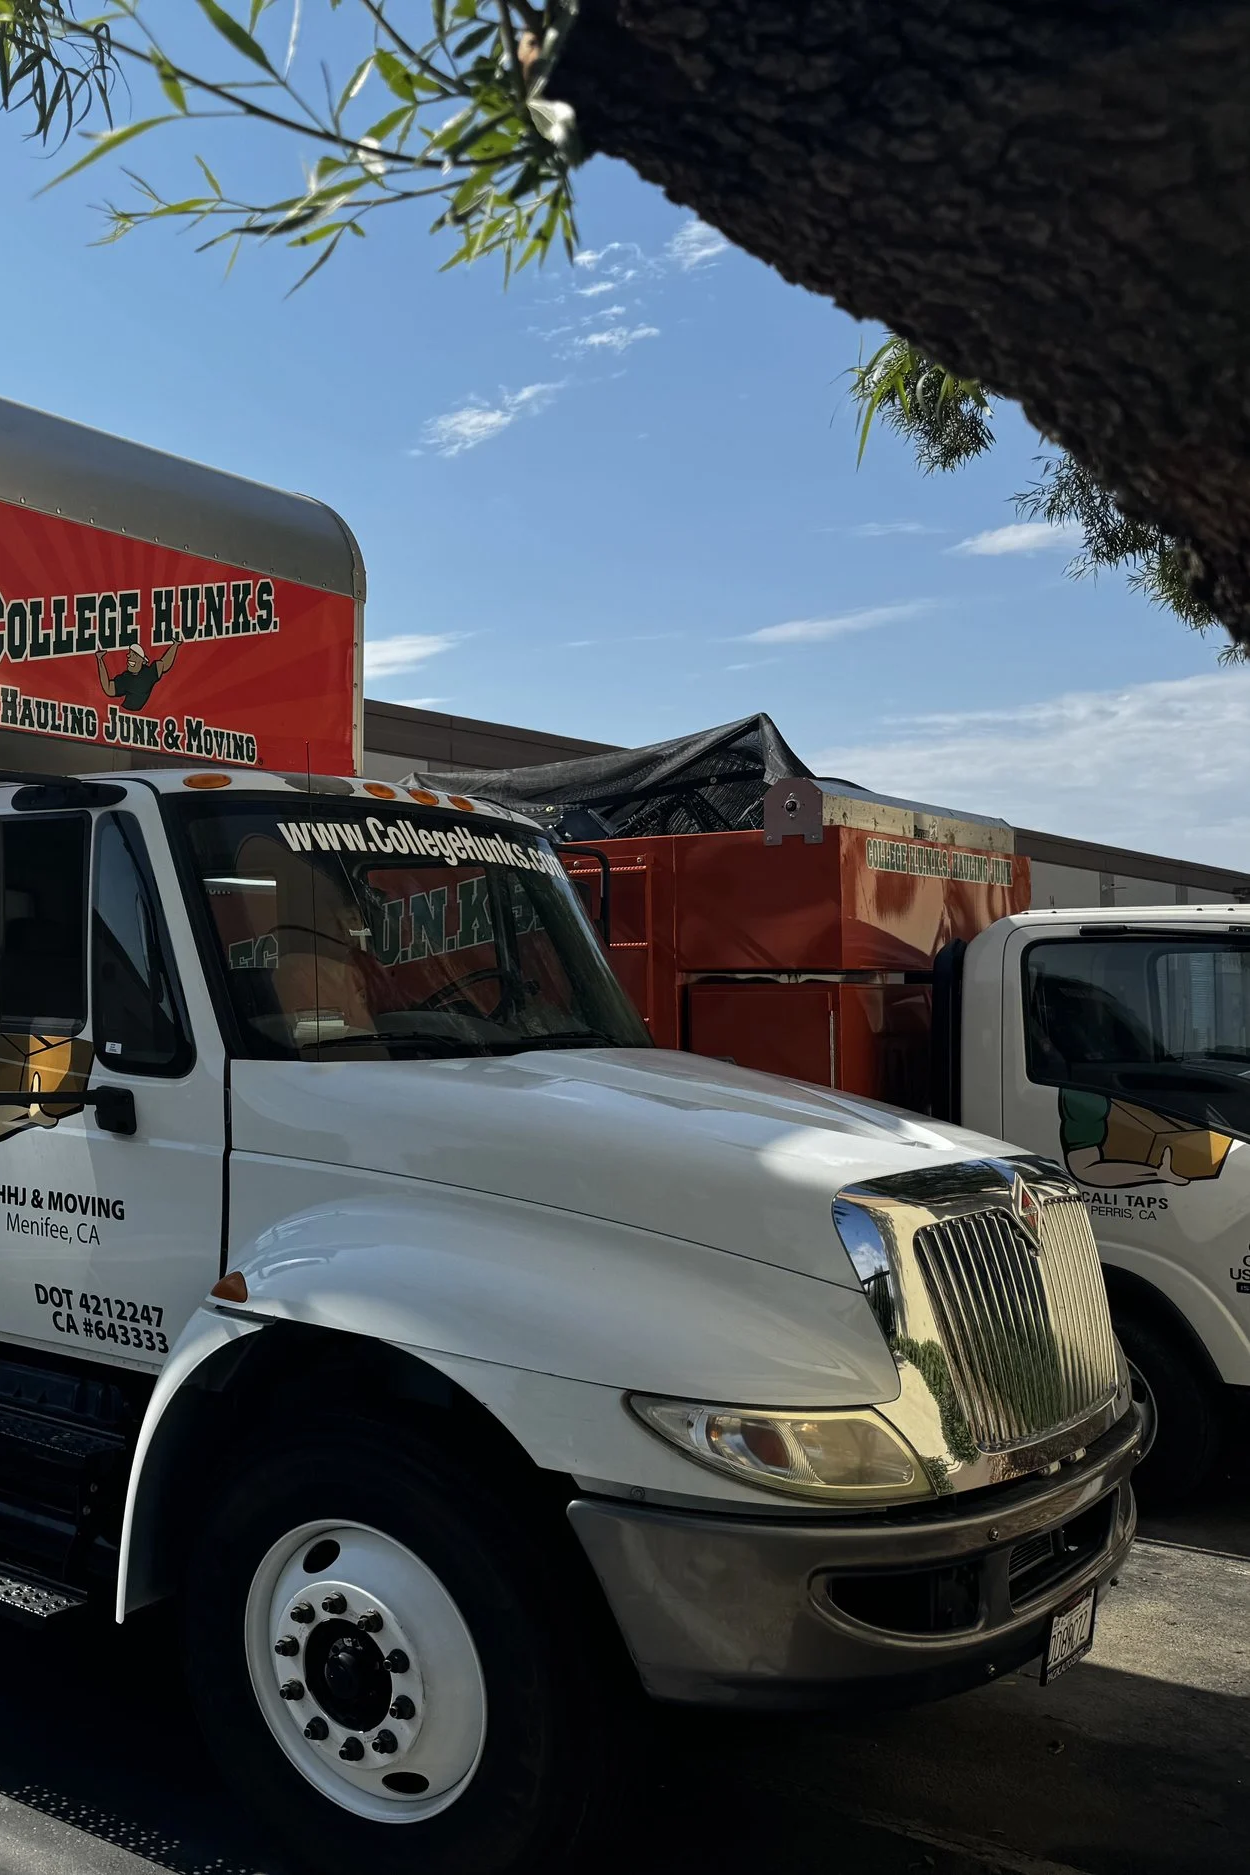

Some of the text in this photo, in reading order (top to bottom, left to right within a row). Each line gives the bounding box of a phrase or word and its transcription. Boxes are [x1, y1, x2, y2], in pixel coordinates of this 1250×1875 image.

[150, 578, 279, 647] H.U.N.K.S.
[0, 684, 258, 765] HAULING JUNK & MOVING
[276, 816, 569, 882] www.CollegeHunks.com
[866, 837, 907, 874] COLLEGE
[951, 851, 989, 884] HAULING
[990, 857, 1013, 887] JUNK
[31, 1189, 44, 1210] &
[48, 1190, 125, 1221] MOVING
[1081, 1191, 1169, 1209] CALI TAPS
[1091, 1205, 1157, 1220] PERRIS, CA
[6, 1212, 100, 1245] Menifee, CA
[34, 1283, 164, 1328] DOT 4212247
[52, 1311, 170, 1354] CA #643333
